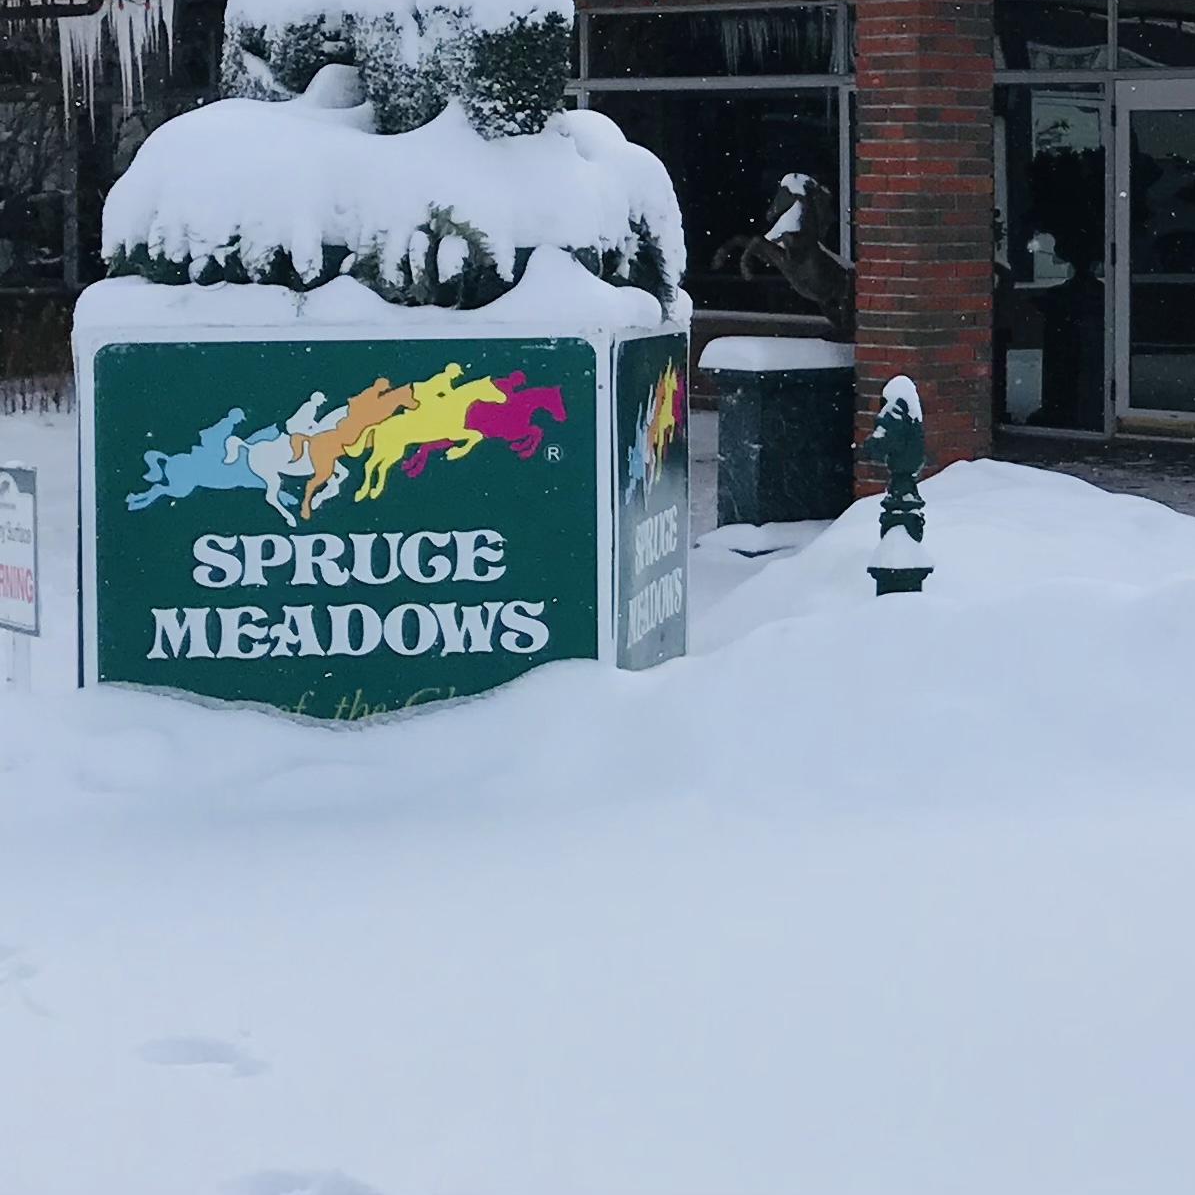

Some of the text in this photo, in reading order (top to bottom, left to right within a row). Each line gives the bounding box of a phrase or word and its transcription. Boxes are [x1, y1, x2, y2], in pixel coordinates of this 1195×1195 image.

[192, 529, 507, 588] SPRUCE
[146, 601, 550, 660] MEADOWS
[626, 566, 683, 650] MEADOWS
